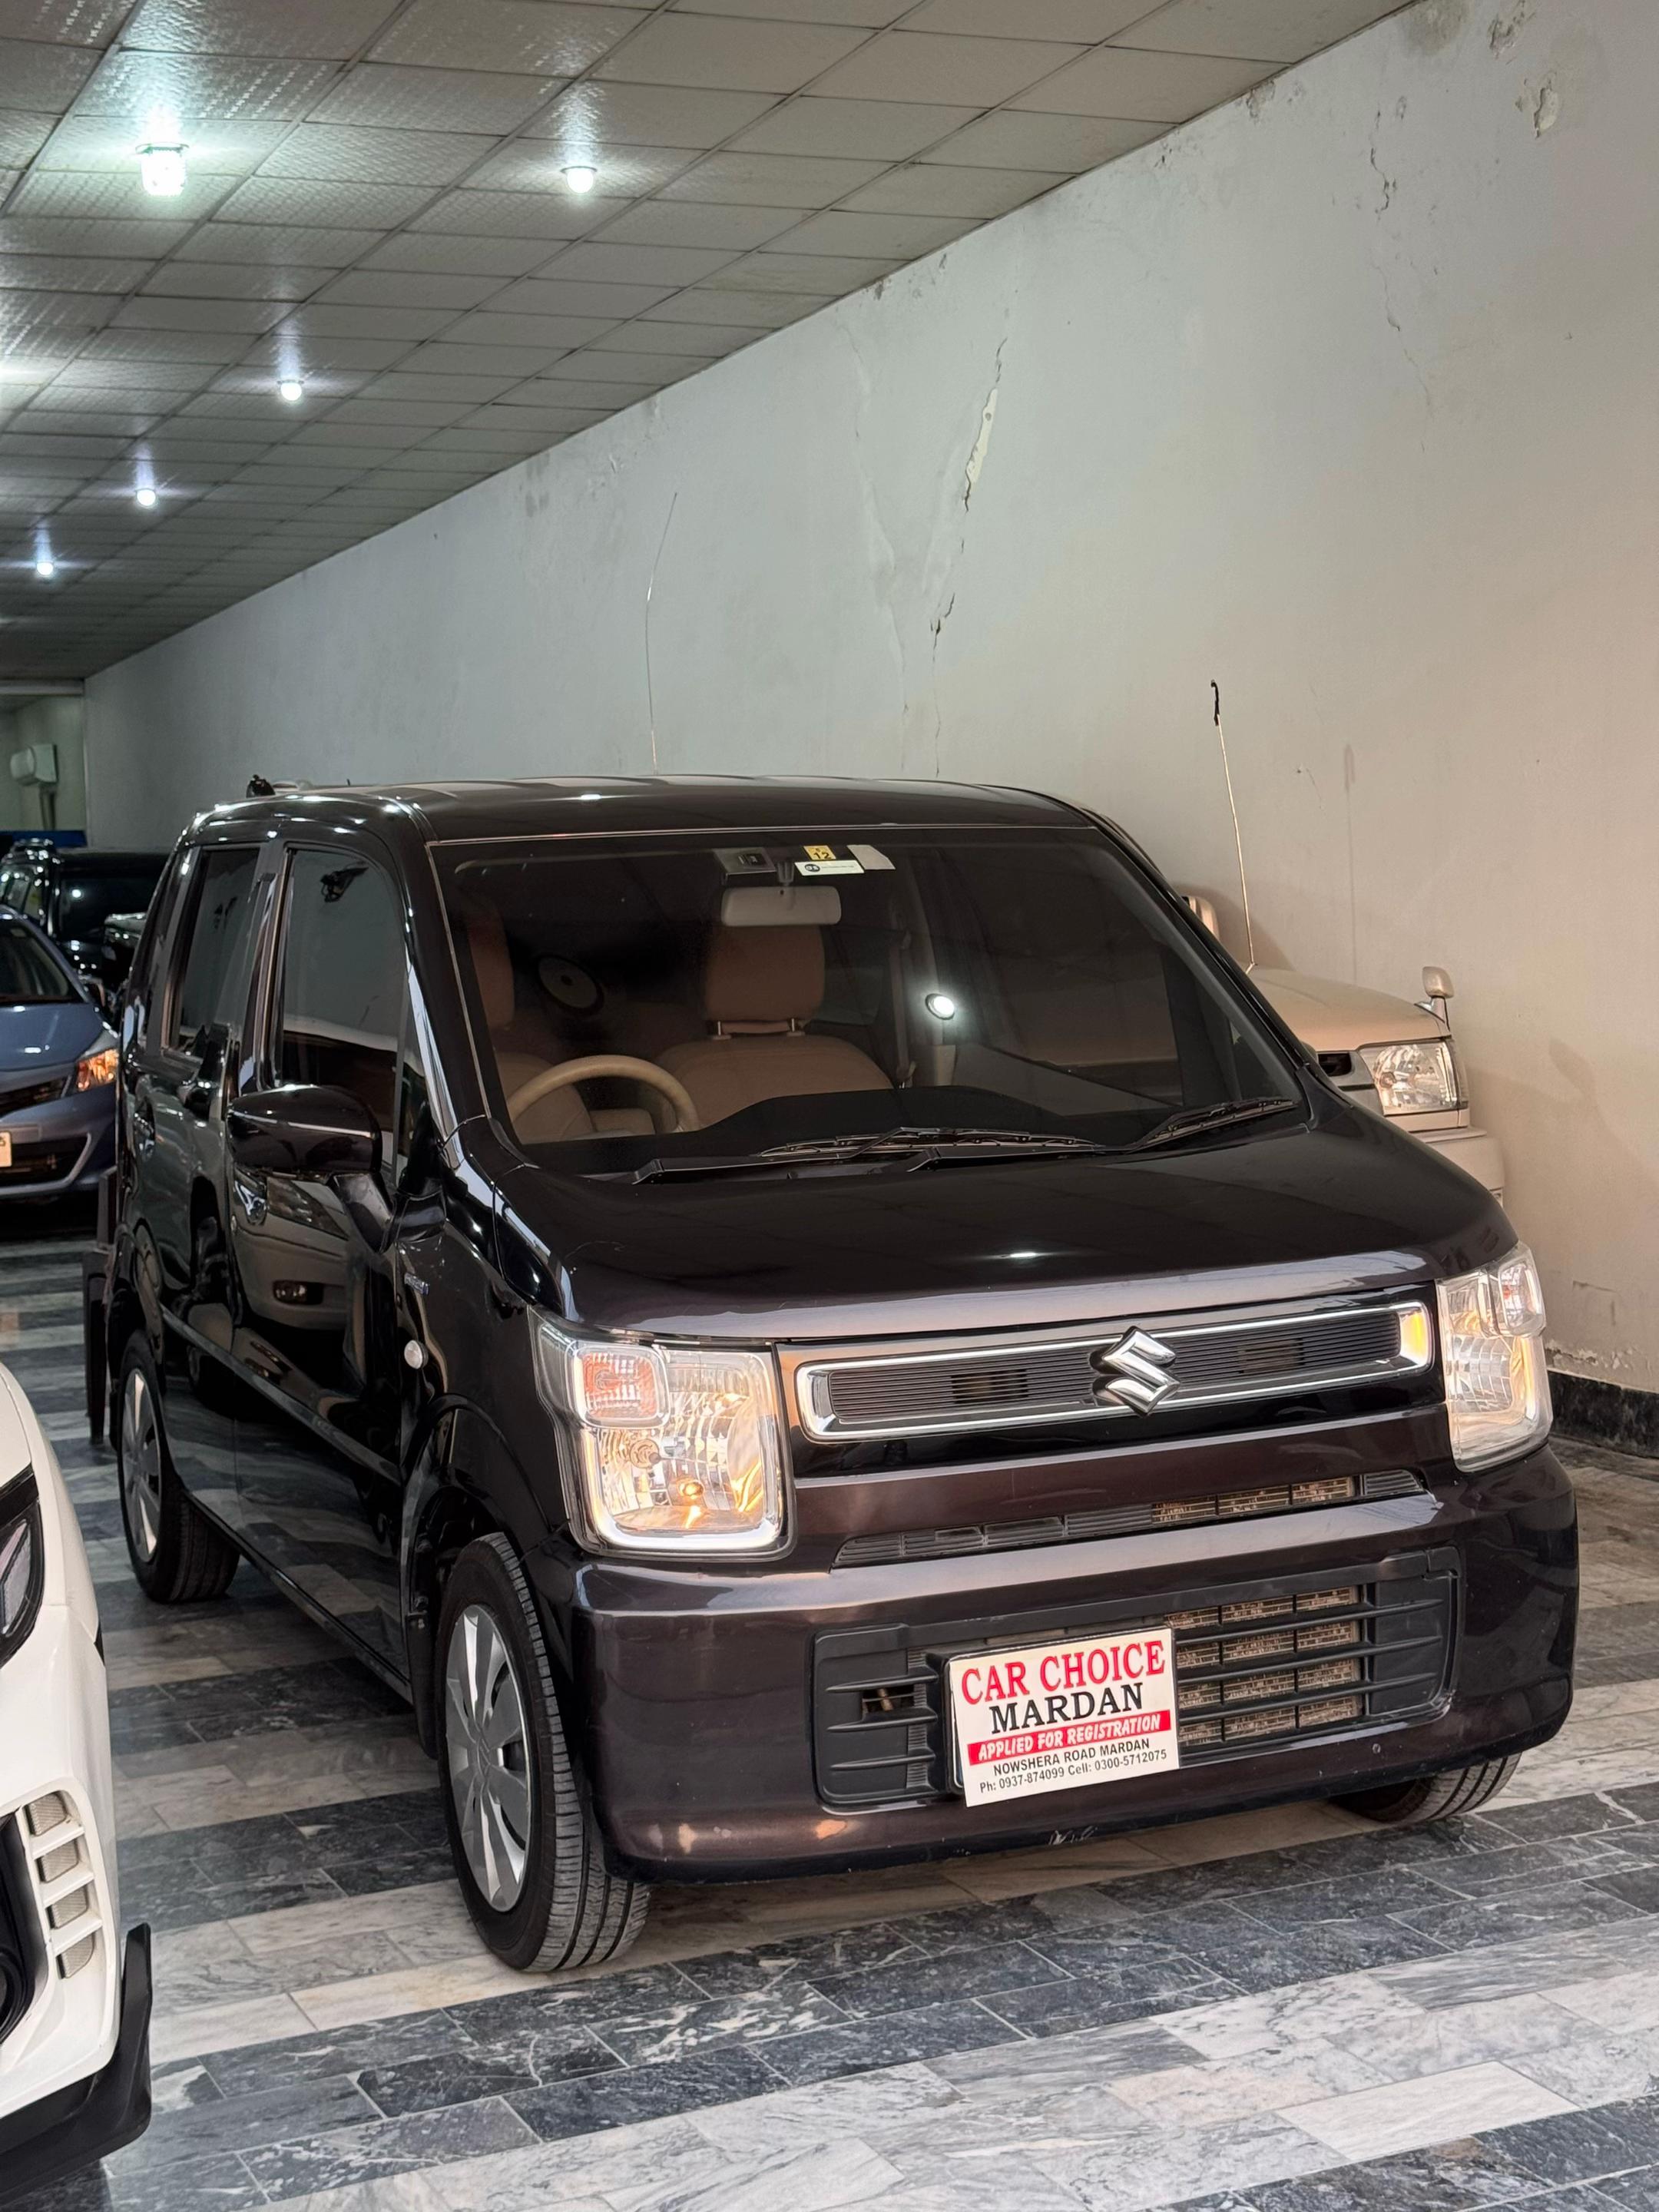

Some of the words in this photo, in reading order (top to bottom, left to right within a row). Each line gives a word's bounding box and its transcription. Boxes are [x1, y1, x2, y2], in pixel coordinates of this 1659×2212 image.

[814, 851, 832, 859] 12
[962, 1661, 1030, 1705] CAR
[1039, 1640, 1166, 1692] CHOICE
[989, 1682, 1143, 1734] MARDAN
[978, 1735, 1034, 1762] APPLIED
[1037, 1729, 1064, 1750] FOR
[1066, 1714, 1161, 1744] REGISTRATION
[993, 1753, 1060, 1777] NOWSHERA
[1064, 1747, 1096, 1763] ROAD
[1100, 1738, 1151, 1757] MARDAN
[979, 1781, 996, 1793] Ph:
[998, 1767, 1065, 1790] 0937-874099
[1068, 1762, 1092, 1776] Cell:
[1094, 1749, 1167, 1771] 0300-5712075
